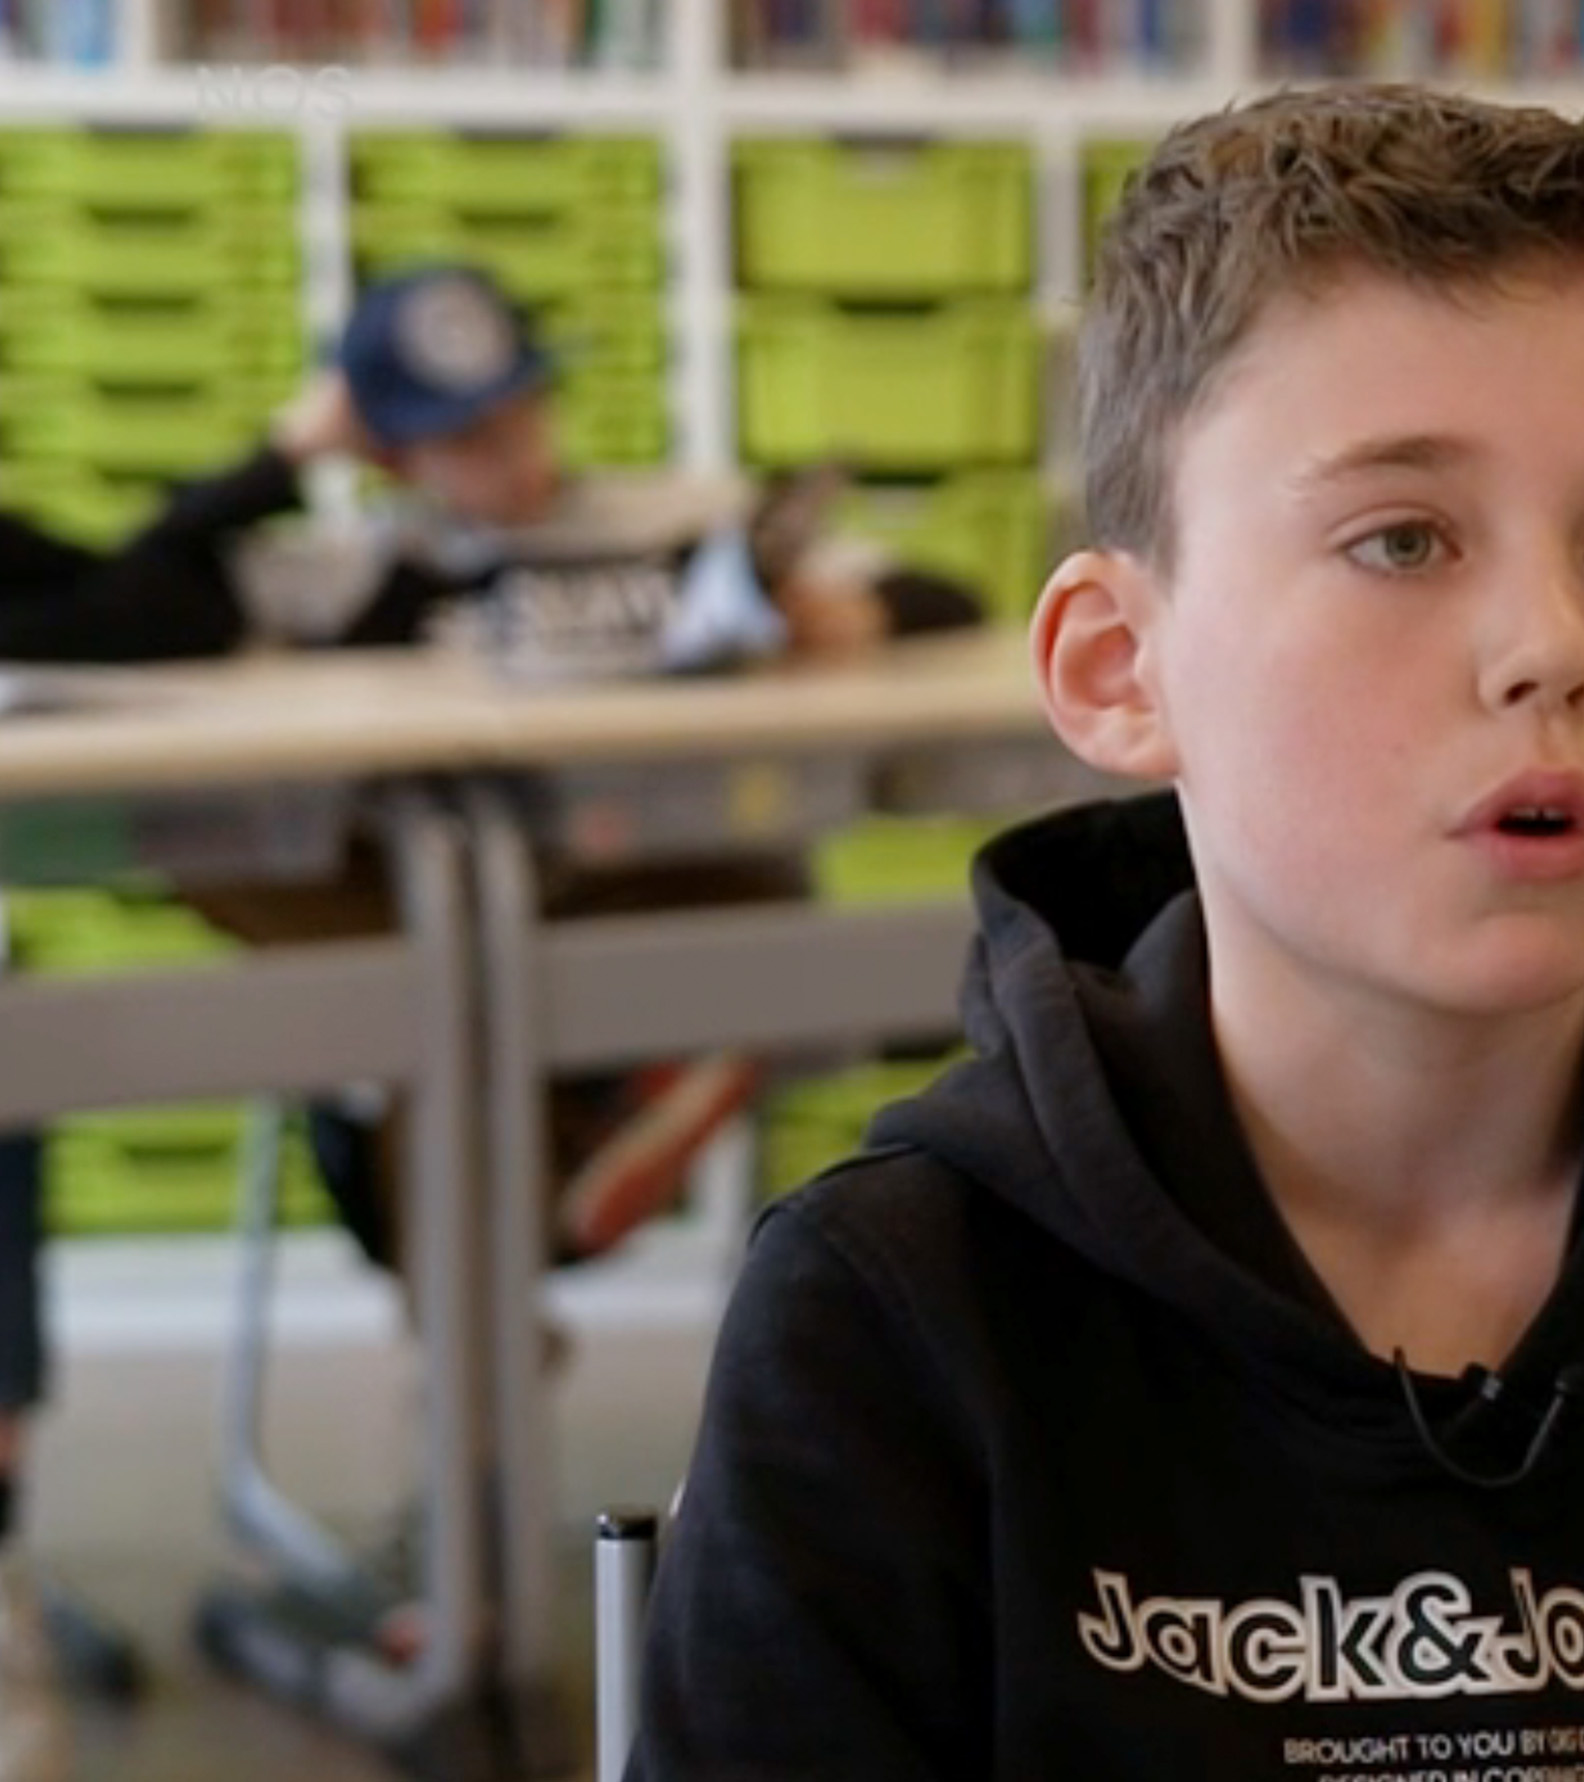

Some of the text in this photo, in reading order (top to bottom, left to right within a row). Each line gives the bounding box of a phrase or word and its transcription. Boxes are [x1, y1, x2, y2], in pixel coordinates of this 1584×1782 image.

[1283, 1735, 1409, 1764] BROUGHT
[1417, 1732, 1454, 1760] TO
[1457, 1730, 1515, 1759] YOU
[1520, 1728, 1546, 1756] BY
